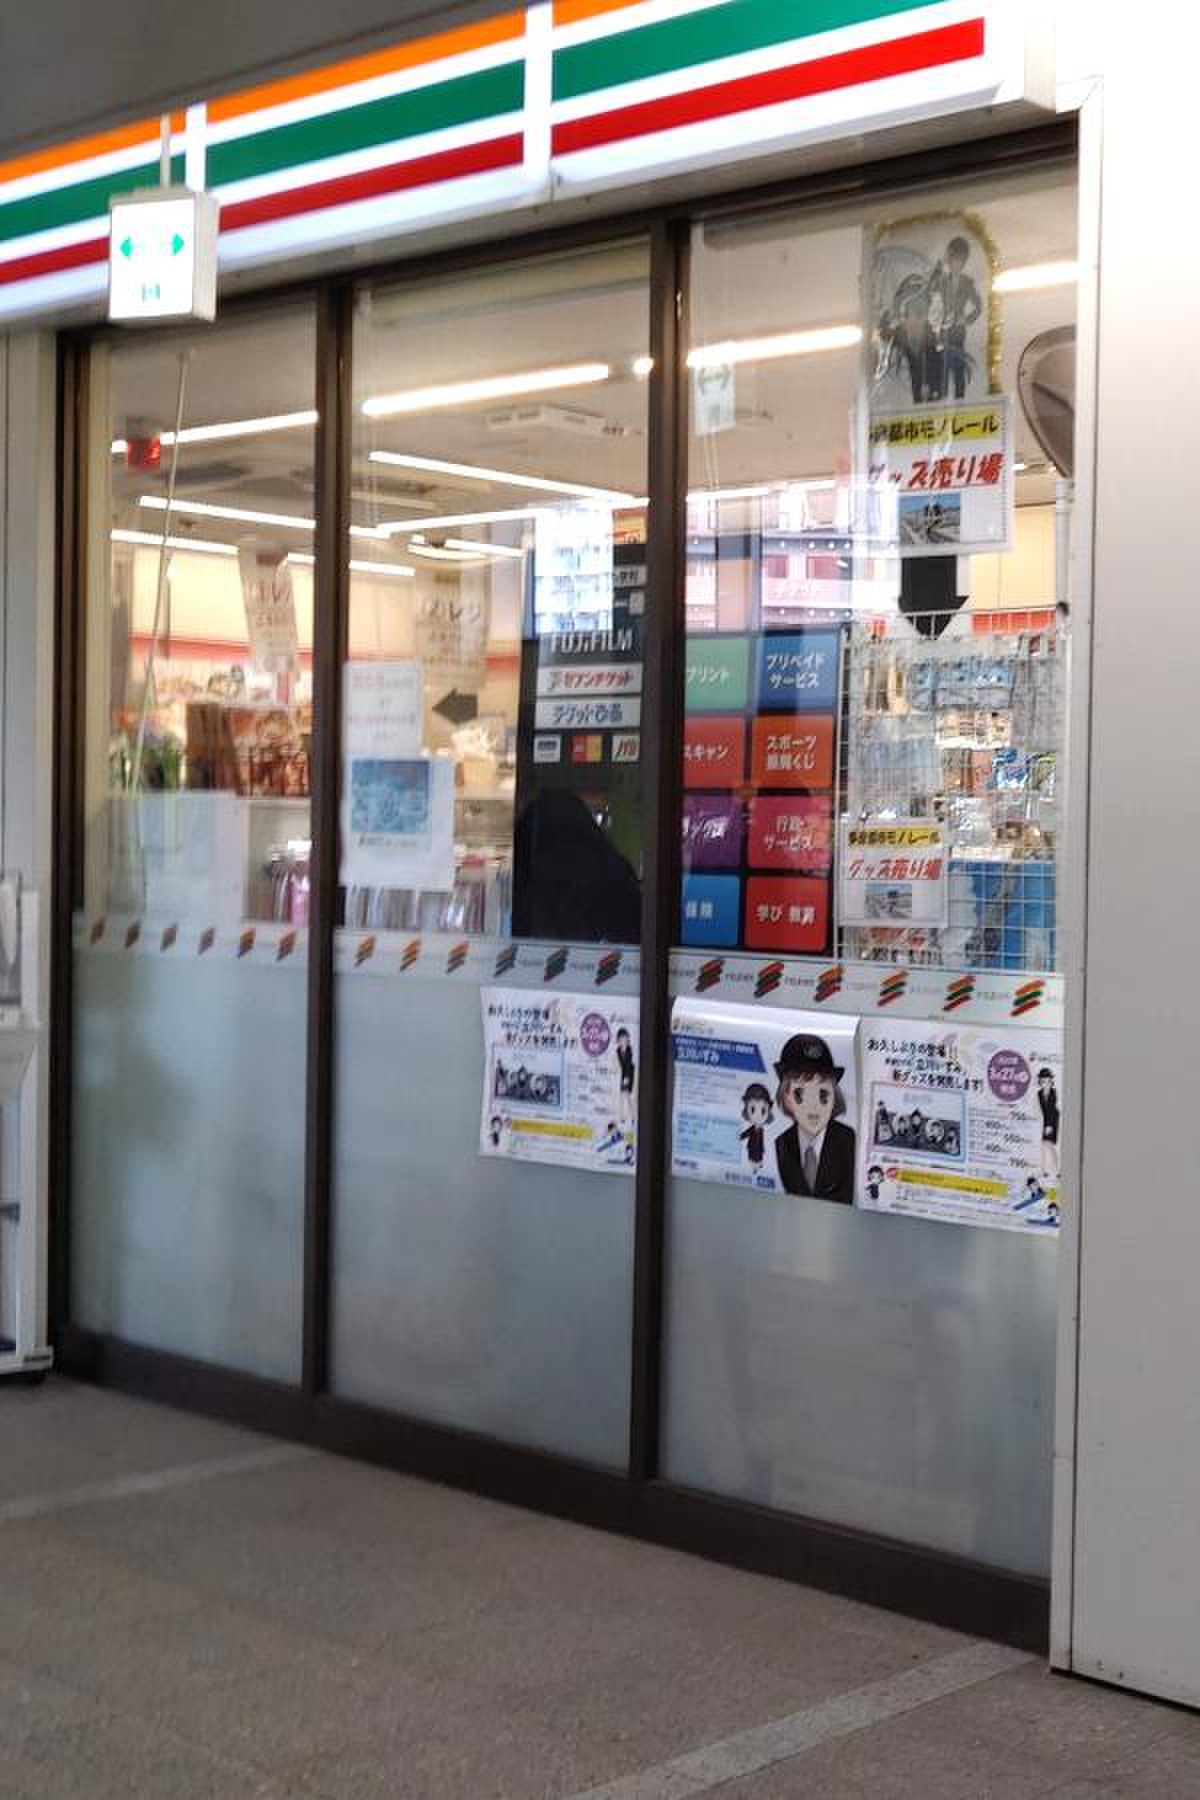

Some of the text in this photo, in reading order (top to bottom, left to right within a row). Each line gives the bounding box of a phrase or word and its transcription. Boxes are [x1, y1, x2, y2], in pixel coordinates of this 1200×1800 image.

[551, 629, 633, 653] FUJIFILM
[769, 672, 819, 689] サービス
[767, 735, 817, 750] スポーツ
